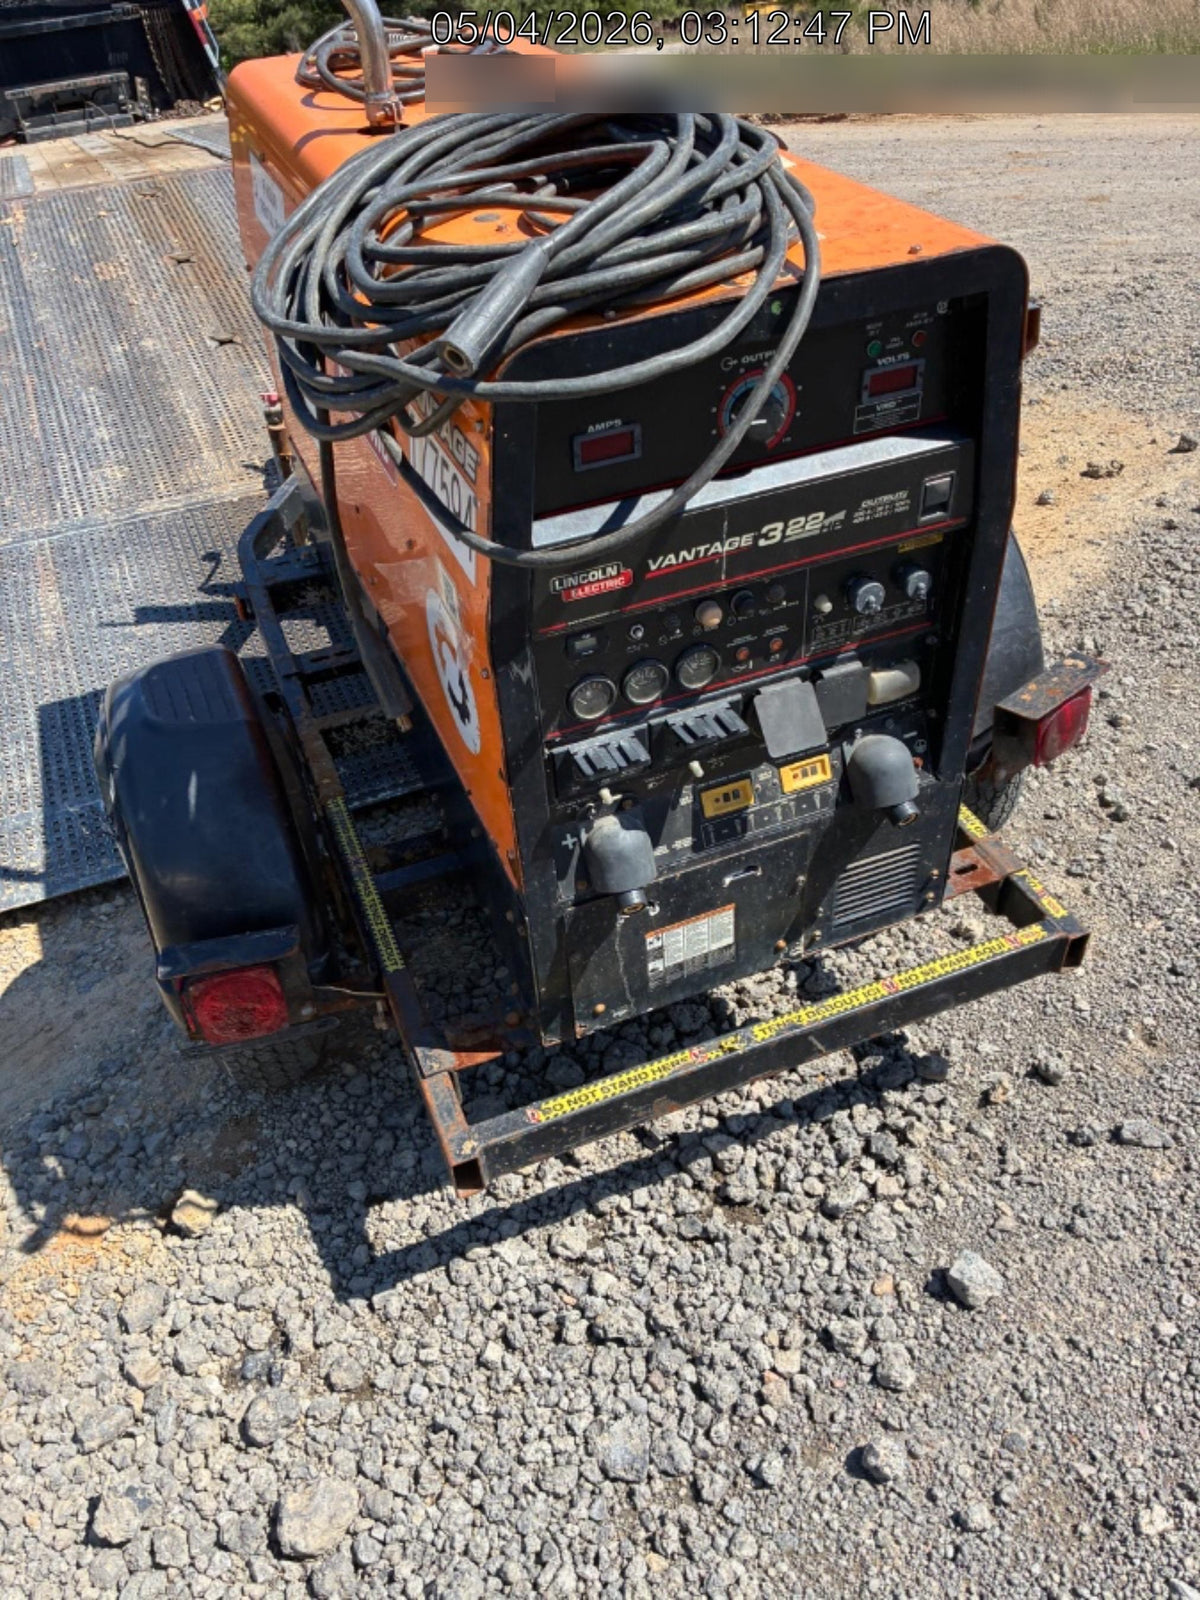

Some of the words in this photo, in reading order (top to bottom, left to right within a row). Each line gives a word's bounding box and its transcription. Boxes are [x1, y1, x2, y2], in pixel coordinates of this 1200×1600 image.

[741, 350, 777, 364] OUTP
[588, 418, 622, 433] AMPS
[646, 532, 755, 571] VANTAGE
[757, 511, 826, 548] 322
[554, 564, 619, 591] LINCOLN
[571, 576, 627, 598] ELECTRIC
[566, 1089, 598, 1106] NOT
[600, 1071, 650, 1094] STAND
